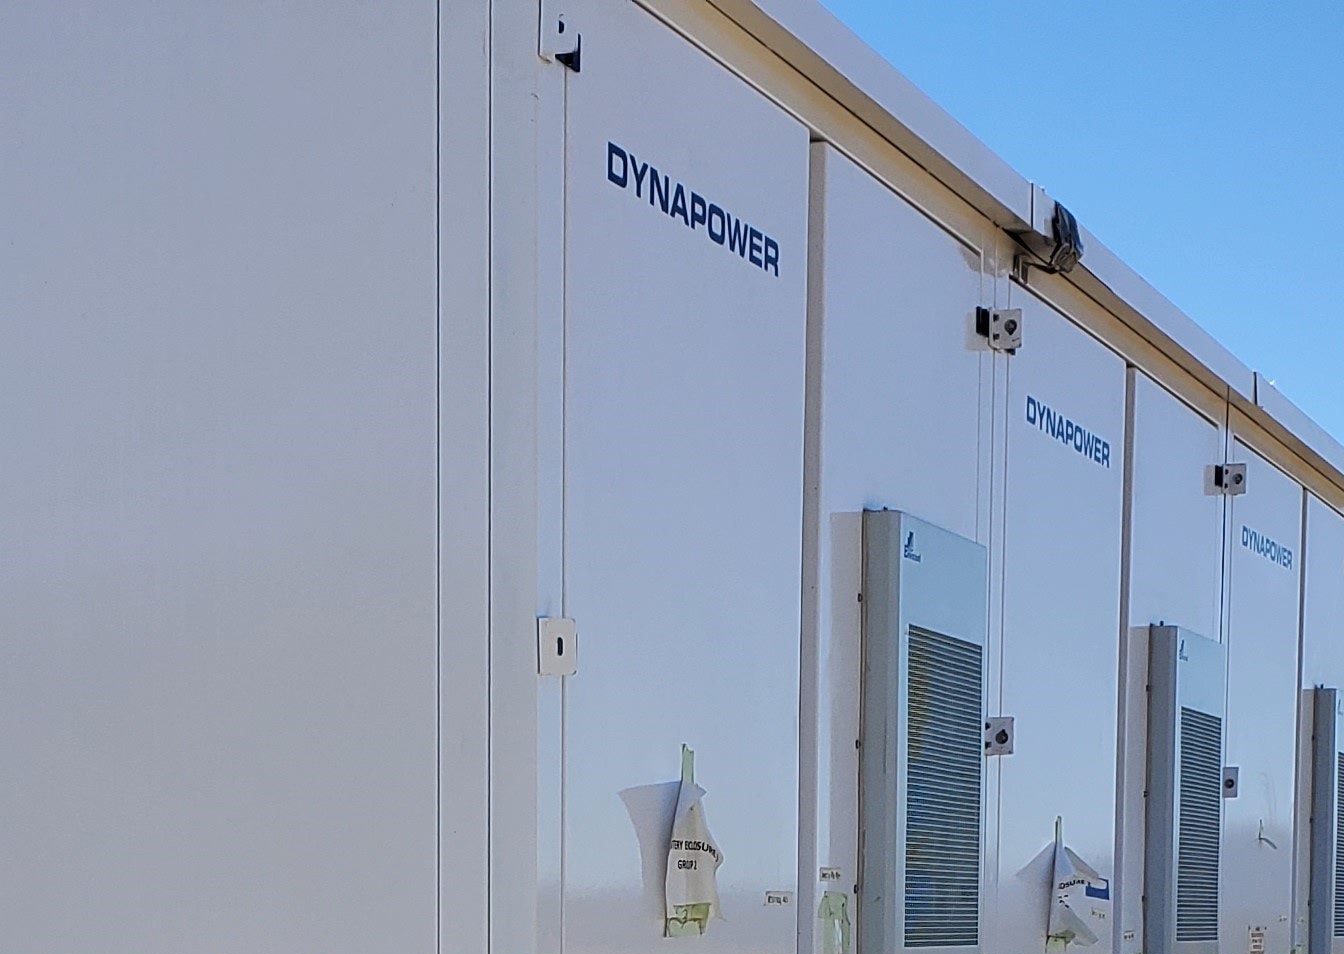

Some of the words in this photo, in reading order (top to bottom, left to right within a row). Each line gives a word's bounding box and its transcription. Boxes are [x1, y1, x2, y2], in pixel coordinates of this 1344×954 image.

[607, 140, 780, 278] DYNAPOWER
[1026, 395, 1111, 469] DYNAPOWER
[1241, 524, 1293, 571] DYNAPOWER
